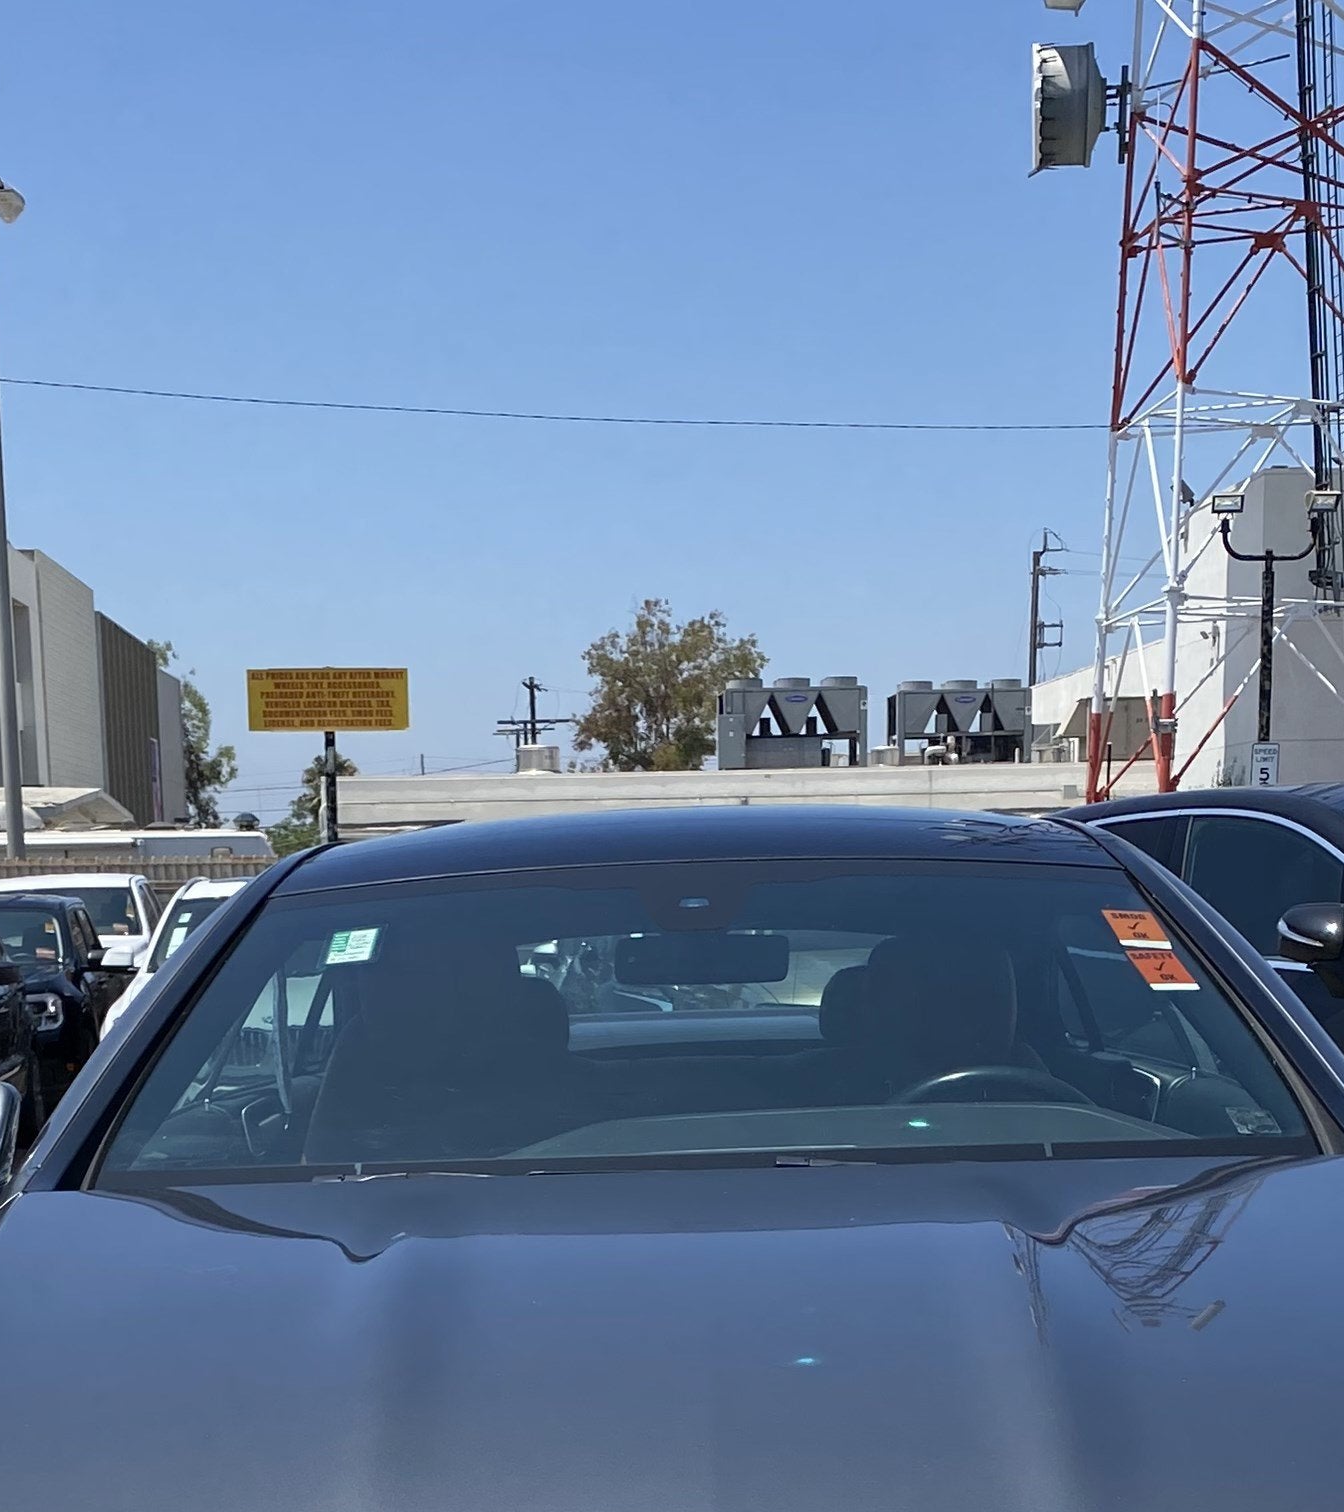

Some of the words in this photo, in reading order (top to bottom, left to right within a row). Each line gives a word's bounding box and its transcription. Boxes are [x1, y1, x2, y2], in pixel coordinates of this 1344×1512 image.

[265, 672, 293, 680] PRICES
[295, 672, 310, 680] ARE
[312, 672, 330, 680] PLUS
[332, 671, 348, 680] ANY
[349, 671, 371, 679] AFTER
[373, 671, 404, 680] MARKET
[273, 682, 304, 690] WHEELS
[306, 691, 349, 699] ANTI-THEFT
[302, 700, 337, 708] LOCATOR
[262, 710, 328, 718] DOCUMENTATION
[299, 719, 315, 727] AND
[317, 719, 373, 727] REGISTRATION
[1259, 767, 1270, 782] 5
[1109, 912, 1147, 920] SMOG
[1132, 931, 1150, 939] OK
[1129, 952, 1174, 960] SAFETY
[1159, 973, 1178, 981] OK
